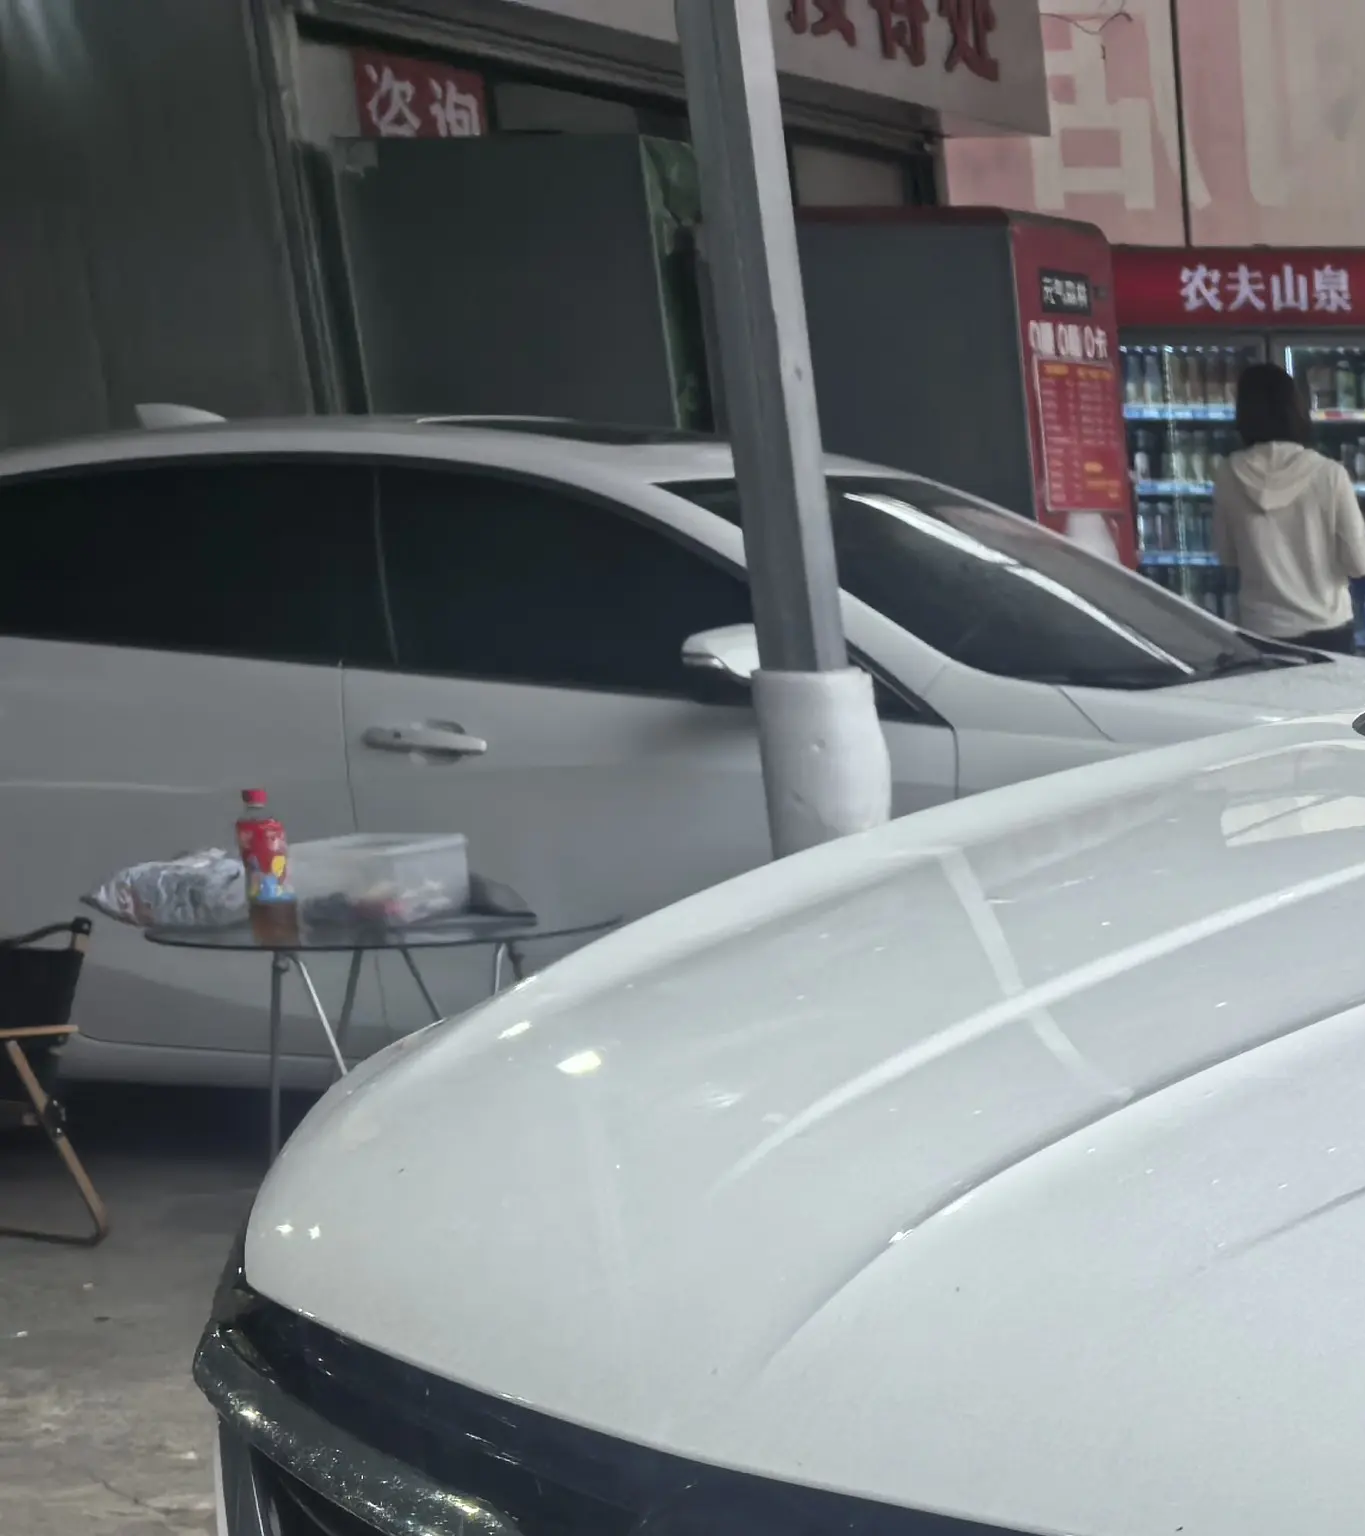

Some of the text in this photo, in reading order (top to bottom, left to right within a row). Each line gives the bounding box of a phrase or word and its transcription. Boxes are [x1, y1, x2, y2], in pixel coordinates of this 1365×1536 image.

[364, 64, 480, 137] 咨询
[1180, 263, 1352, 312] 农夫山泉
